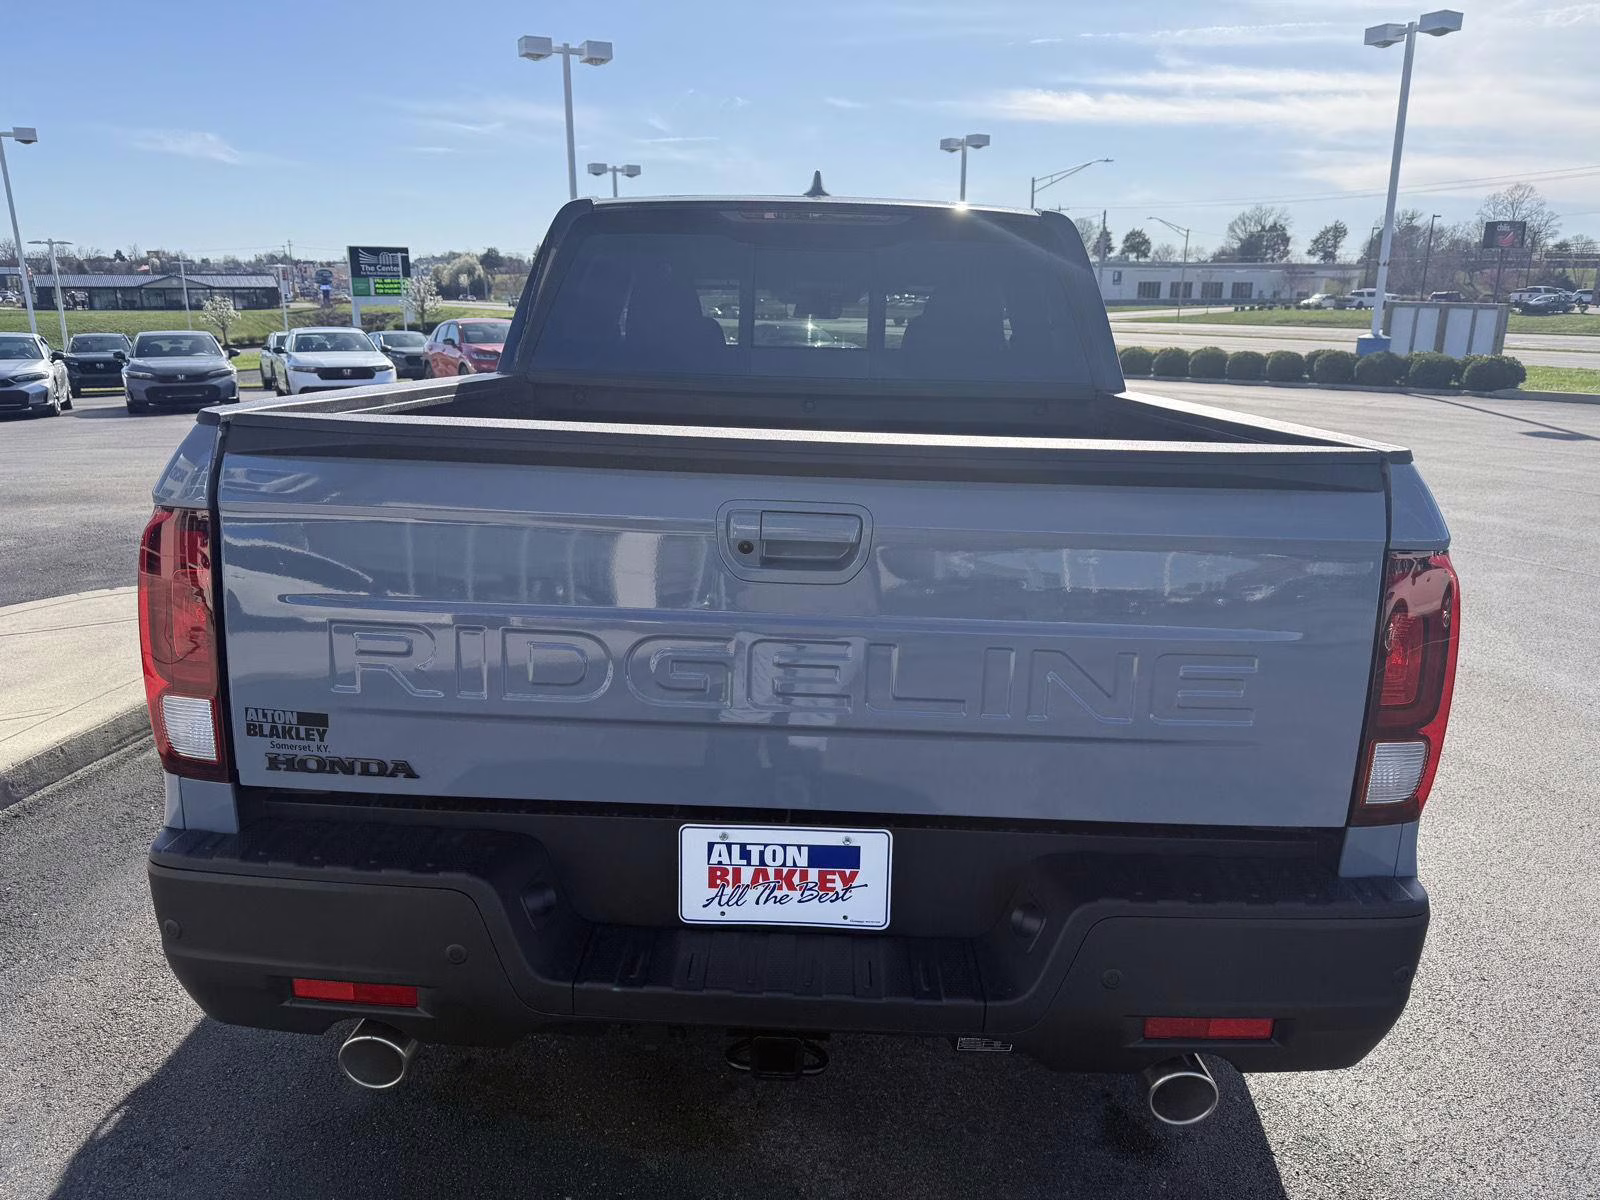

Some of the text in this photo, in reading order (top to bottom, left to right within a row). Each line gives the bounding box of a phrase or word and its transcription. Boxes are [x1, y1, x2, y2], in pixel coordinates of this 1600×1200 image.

[327, 618, 1259, 728] RIDGELINE
[246, 708, 298, 725] ALTON
[246, 723, 328, 742] BLAKLEY
[270, 740, 314, 752] Somerset,
[265, 753, 420, 779] HONDA
[709, 843, 808, 867] ALTON
[708, 866, 860, 892] BLAKLEY
[702, 880, 868, 908] All The Best
